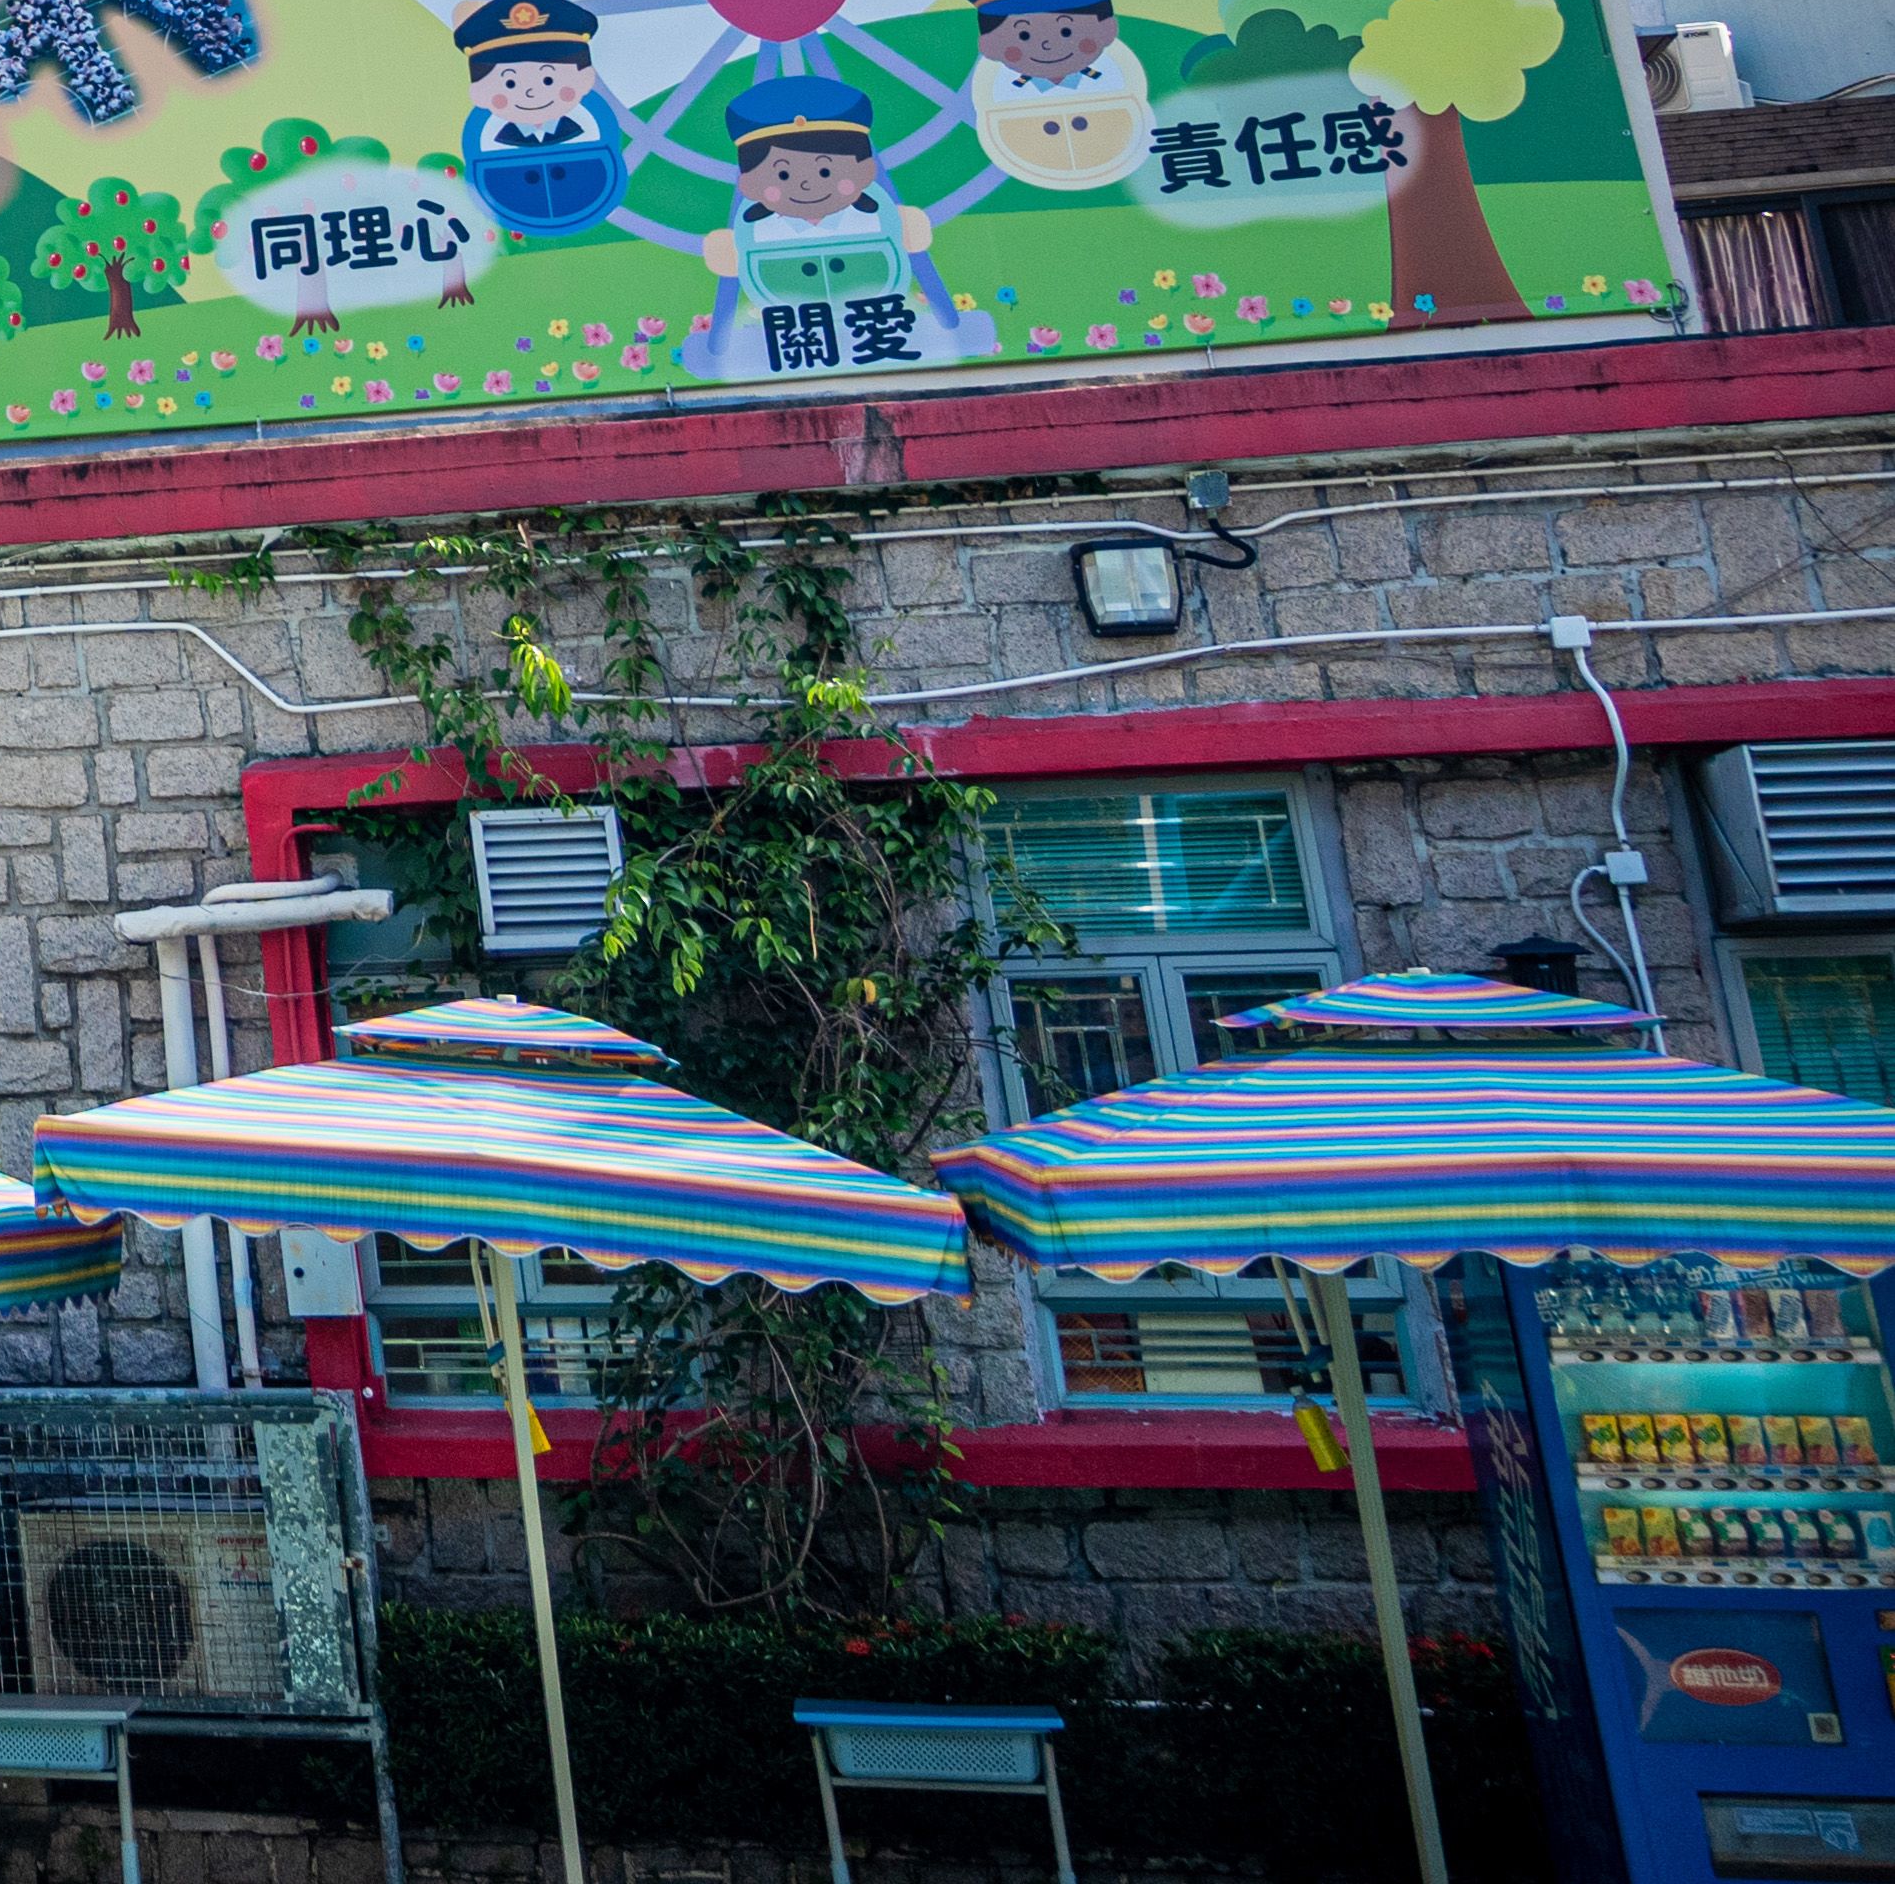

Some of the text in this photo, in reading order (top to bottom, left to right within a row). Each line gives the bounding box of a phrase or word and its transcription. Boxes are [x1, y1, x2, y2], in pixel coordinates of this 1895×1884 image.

[1148, 101, 1409, 195] 責任感
[250, 199, 471, 280] 同理心
[761, 292, 923, 373] 關愛
